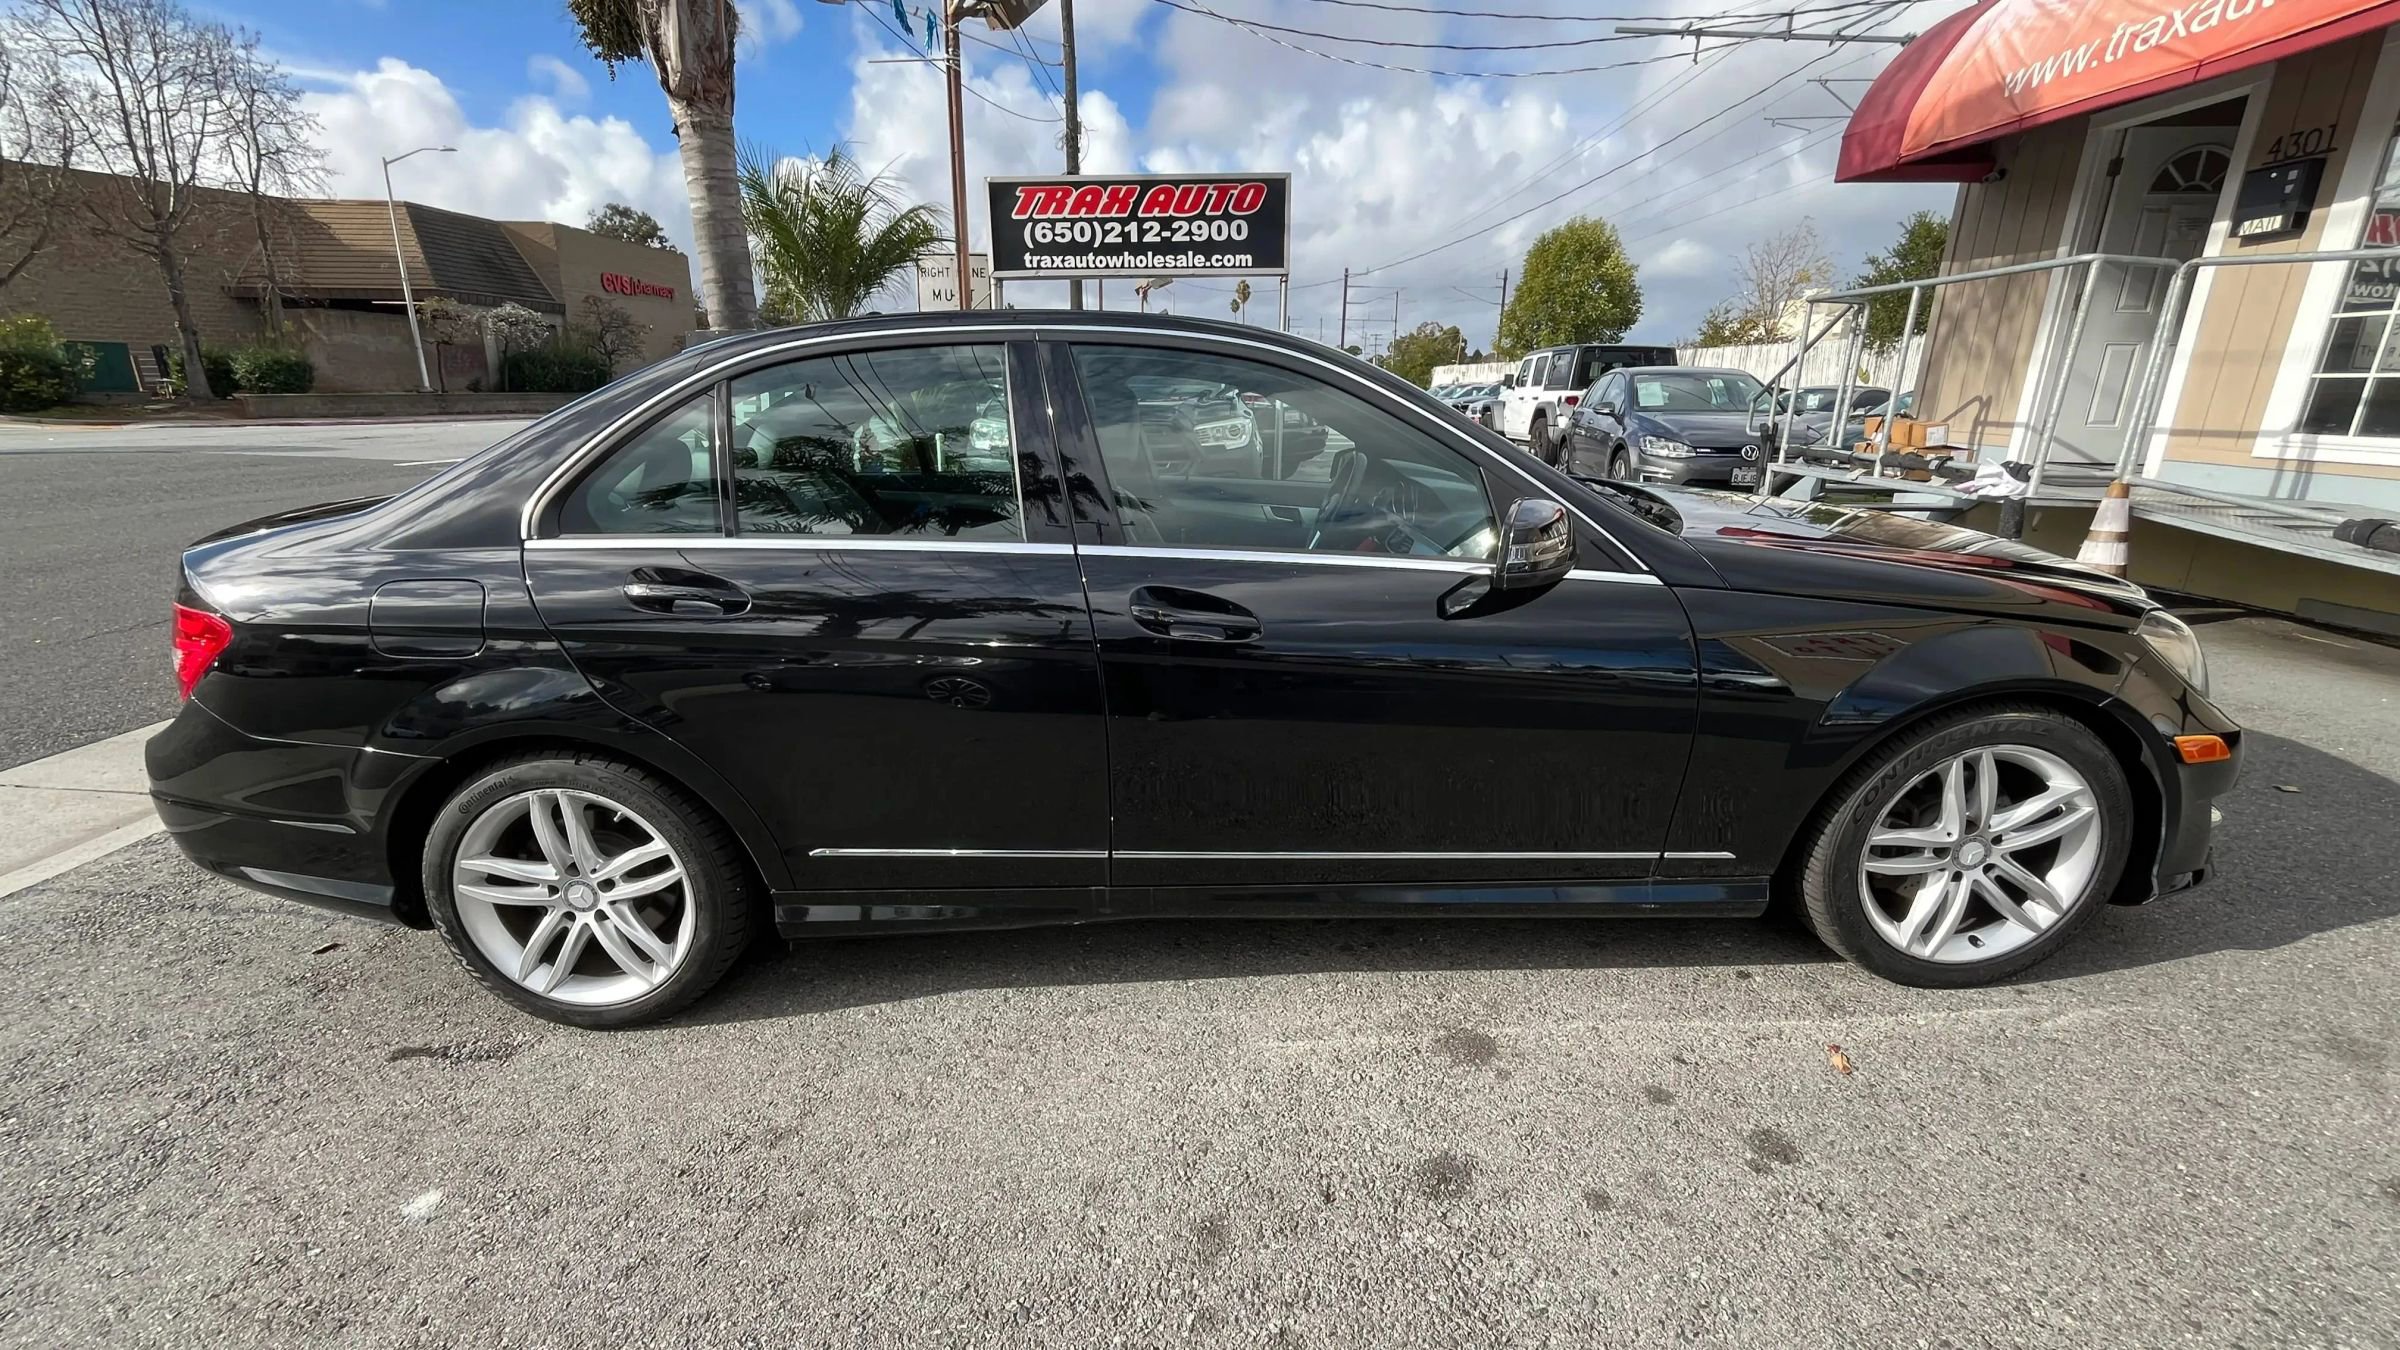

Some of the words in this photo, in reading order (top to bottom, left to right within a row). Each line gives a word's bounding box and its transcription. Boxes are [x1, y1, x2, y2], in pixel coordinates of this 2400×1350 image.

[2266, 123, 2337, 162] 4301
[1012, 185, 1140, 219] TRAX
[1138, 182, 1267, 217] AUTO
[1024, 219, 1248, 248] (650)212-2900
[1024, 251, 1252, 268] traxautowholesale.com
[920, 267, 950, 278] RIGHT
[932, 288, 975, 302] MUT
